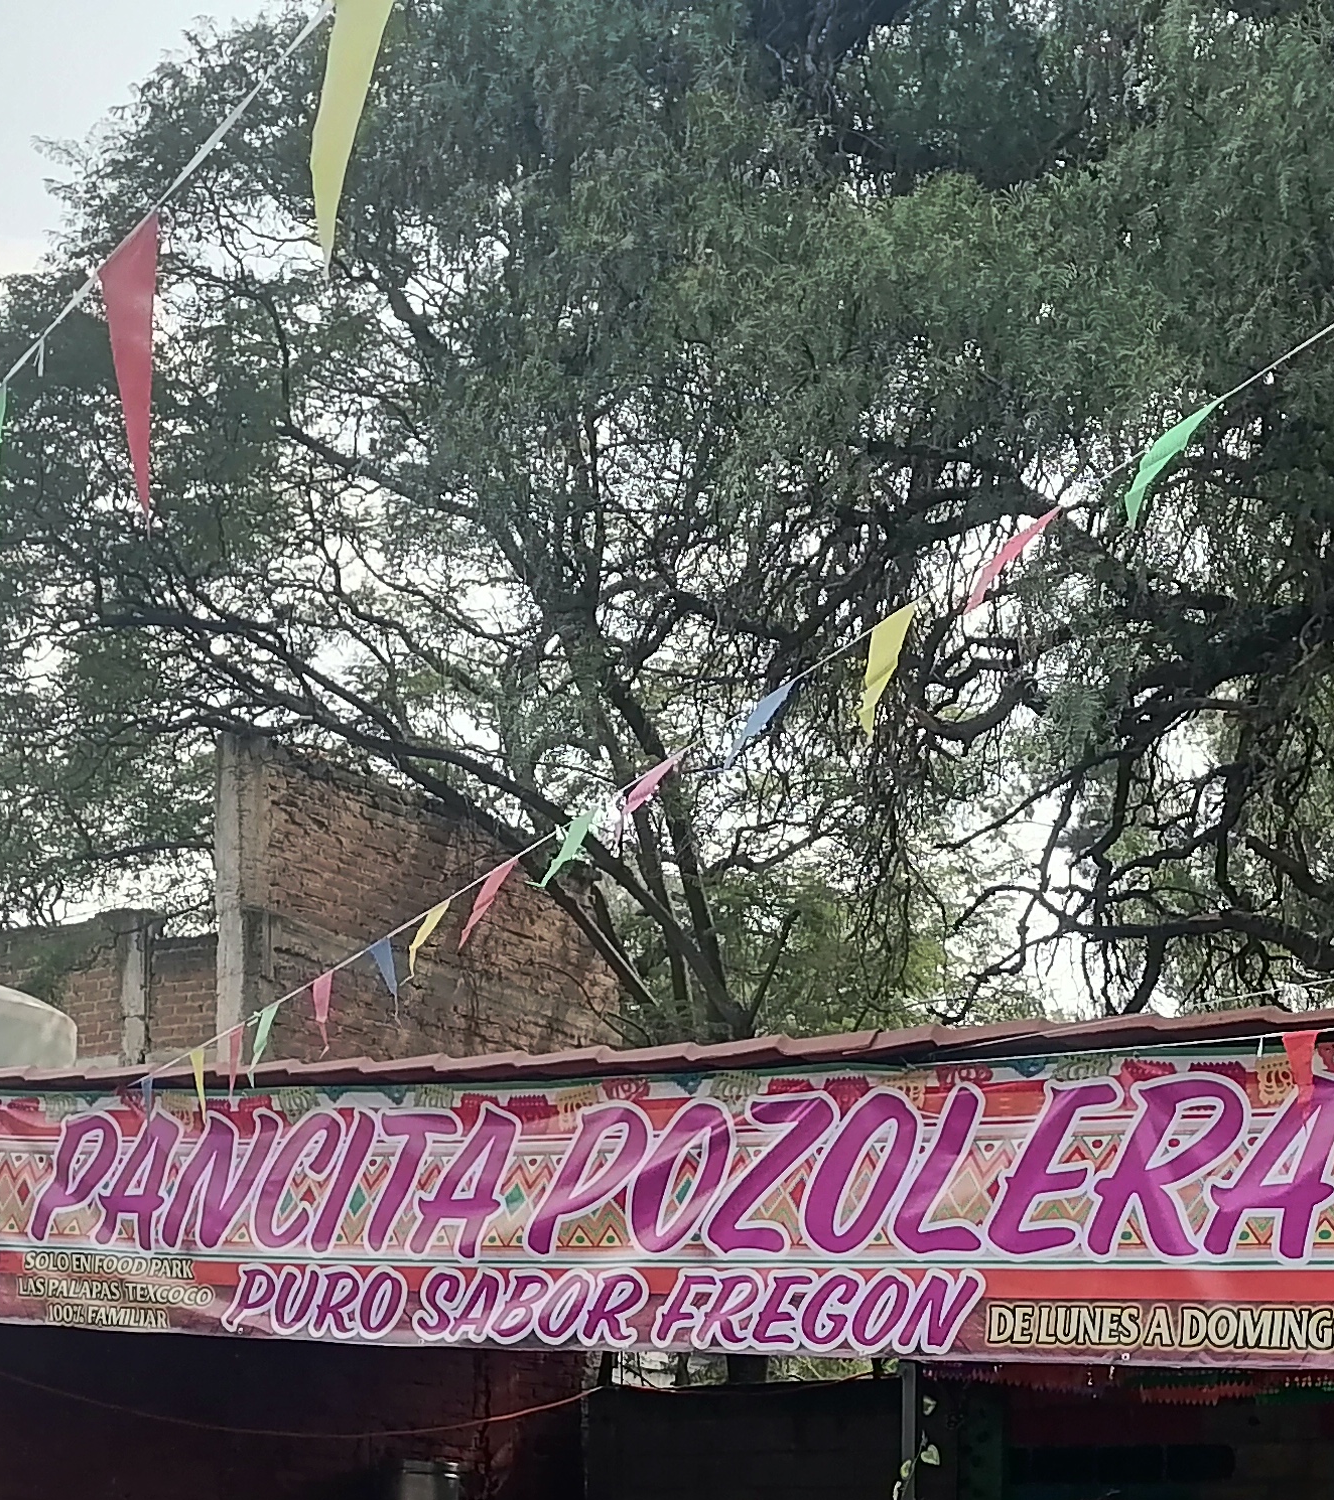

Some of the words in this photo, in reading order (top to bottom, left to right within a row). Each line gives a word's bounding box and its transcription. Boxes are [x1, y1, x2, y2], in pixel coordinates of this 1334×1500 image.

[26, 1102, 524, 1260] PANCITA
[24, 1251, 68, 1271] SOLO
[72, 1255, 94, 1273] EN
[94, 1257, 147, 1276] FOOD
[148, 1259, 194, 1280] PARK
[18, 1277, 45, 1297] LAS
[47, 1280, 120, 1300] PALAPAS
[125, 1283, 214, 1306] TEXCOCO
[221, 1264, 413, 1341] PURO
[414, 1264, 649, 1347] SABOR
[651, 1266, 985, 1354] FREGON
[48, 1304, 84, 1323] 100%
[87, 1306, 170, 1329] FAMILIAR
[986, 1303, 1033, 1347] DE
[1035, 1305, 1141, 1347] LUNES
[1145, 1304, 1176, 1347] A
